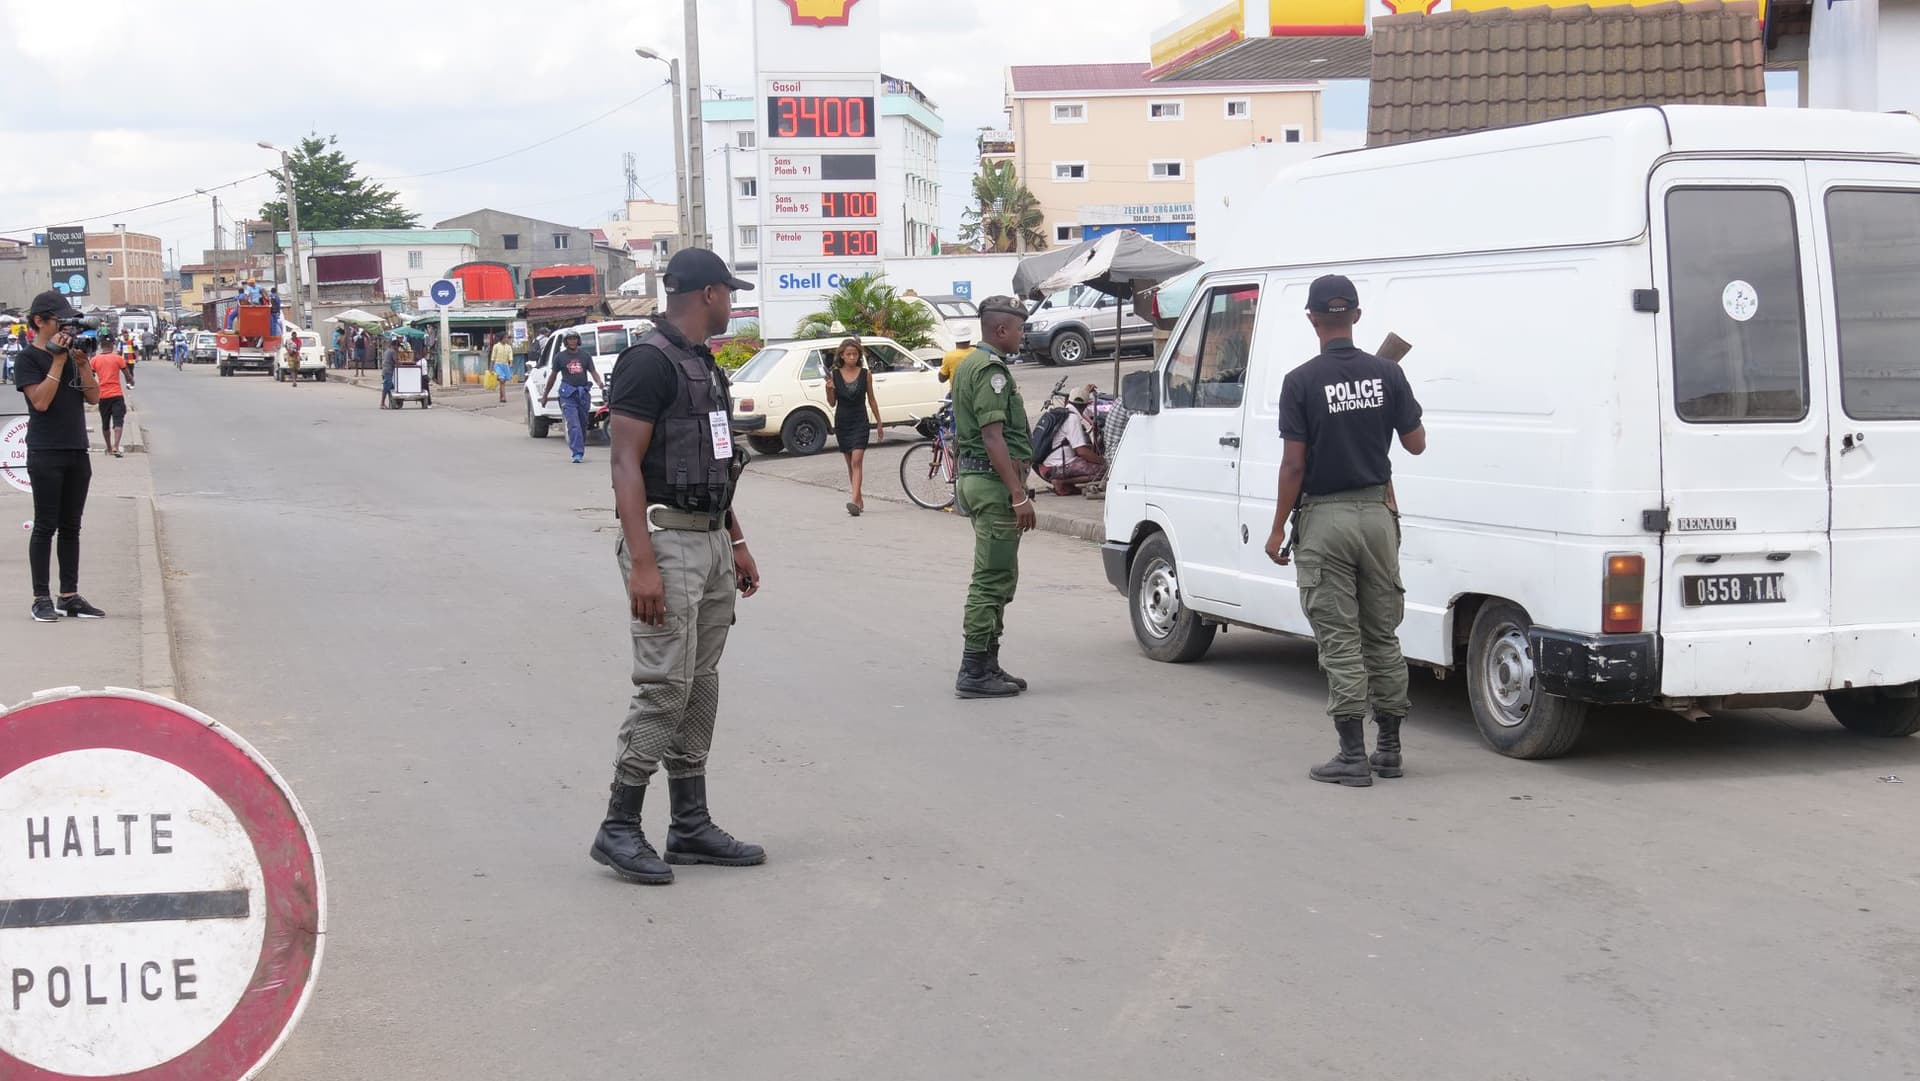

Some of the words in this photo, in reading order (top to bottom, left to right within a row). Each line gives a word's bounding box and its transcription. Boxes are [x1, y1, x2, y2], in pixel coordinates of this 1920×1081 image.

[773, 81, 801, 92] Gasoil
[777, 96, 865, 137] 3400
[774, 157, 791, 166] Sans
[774, 166, 798, 175] Plomb
[802, 166, 811, 175] 91
[775, 194, 792, 203] Sans
[775, 204, 798, 213] Plomb
[800, 204, 809, 213] 95
[775, 232, 802, 241] Pétrole
[51, 258, 65, 267] LIVE
[66, 257, 86, 266] HOTEL
[779, 272, 821, 289] Shell
[827, 271, 869, 288] Ca
[1324, 378, 1384, 403] POLICE
[1328, 396, 1384, 414] NATIONALE
[11, 450, 25, 459] 034
[1678, 517, 1737, 531] RENAULT
[1697, 577, 1741, 602] 0558
[26, 813, 174, 859] HALTE
[11, 958, 198, 1010] POLICE
